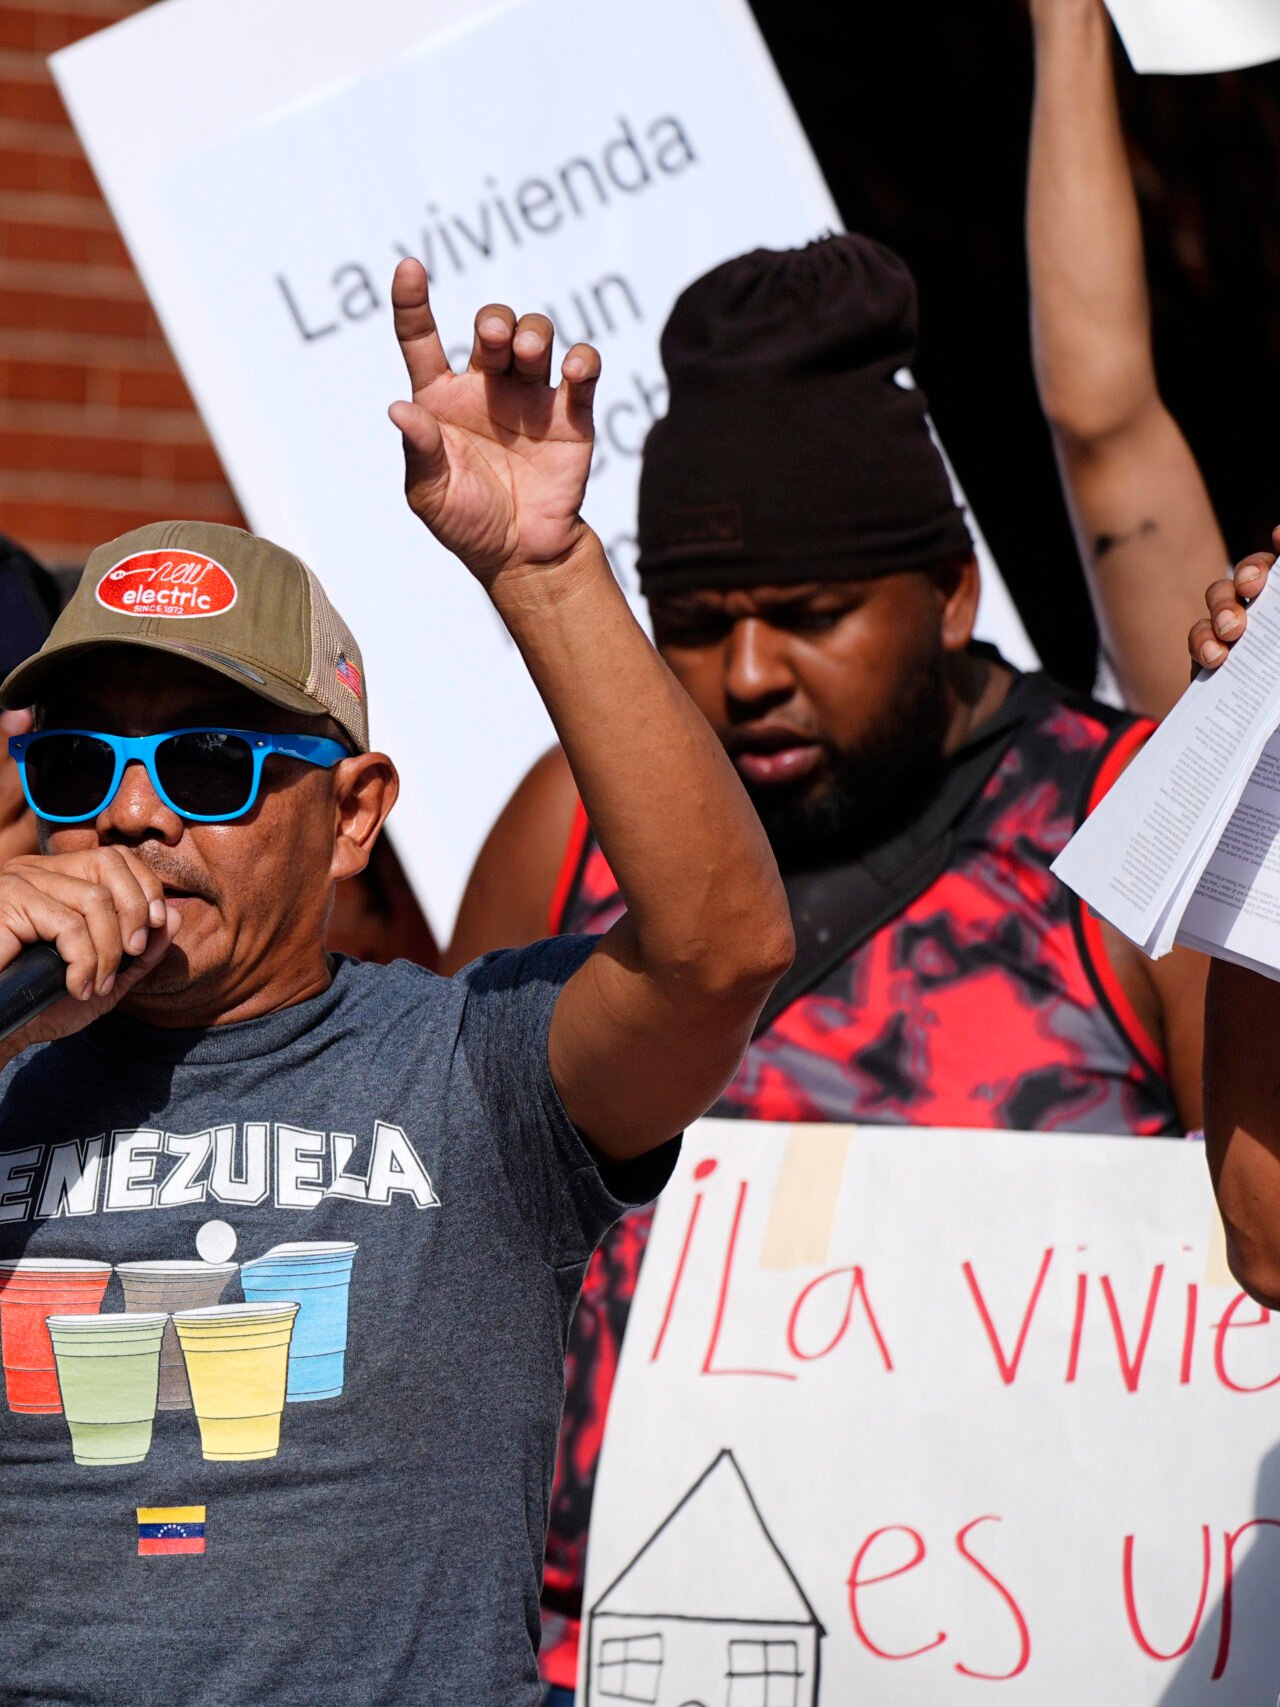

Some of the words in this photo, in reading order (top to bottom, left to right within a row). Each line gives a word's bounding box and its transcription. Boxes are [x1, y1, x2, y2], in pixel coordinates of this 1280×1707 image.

[275, 260, 384, 343] La
[392, 113, 701, 287] vivienda
[543, 271, 644, 350] un
[122, 584, 212, 610] electric
[148, 561, 203, 585] new
[133, 604, 162, 613] SINCE
[164, 605, 185, 615] 1972
[846, 1515, 1030, 1680] es
